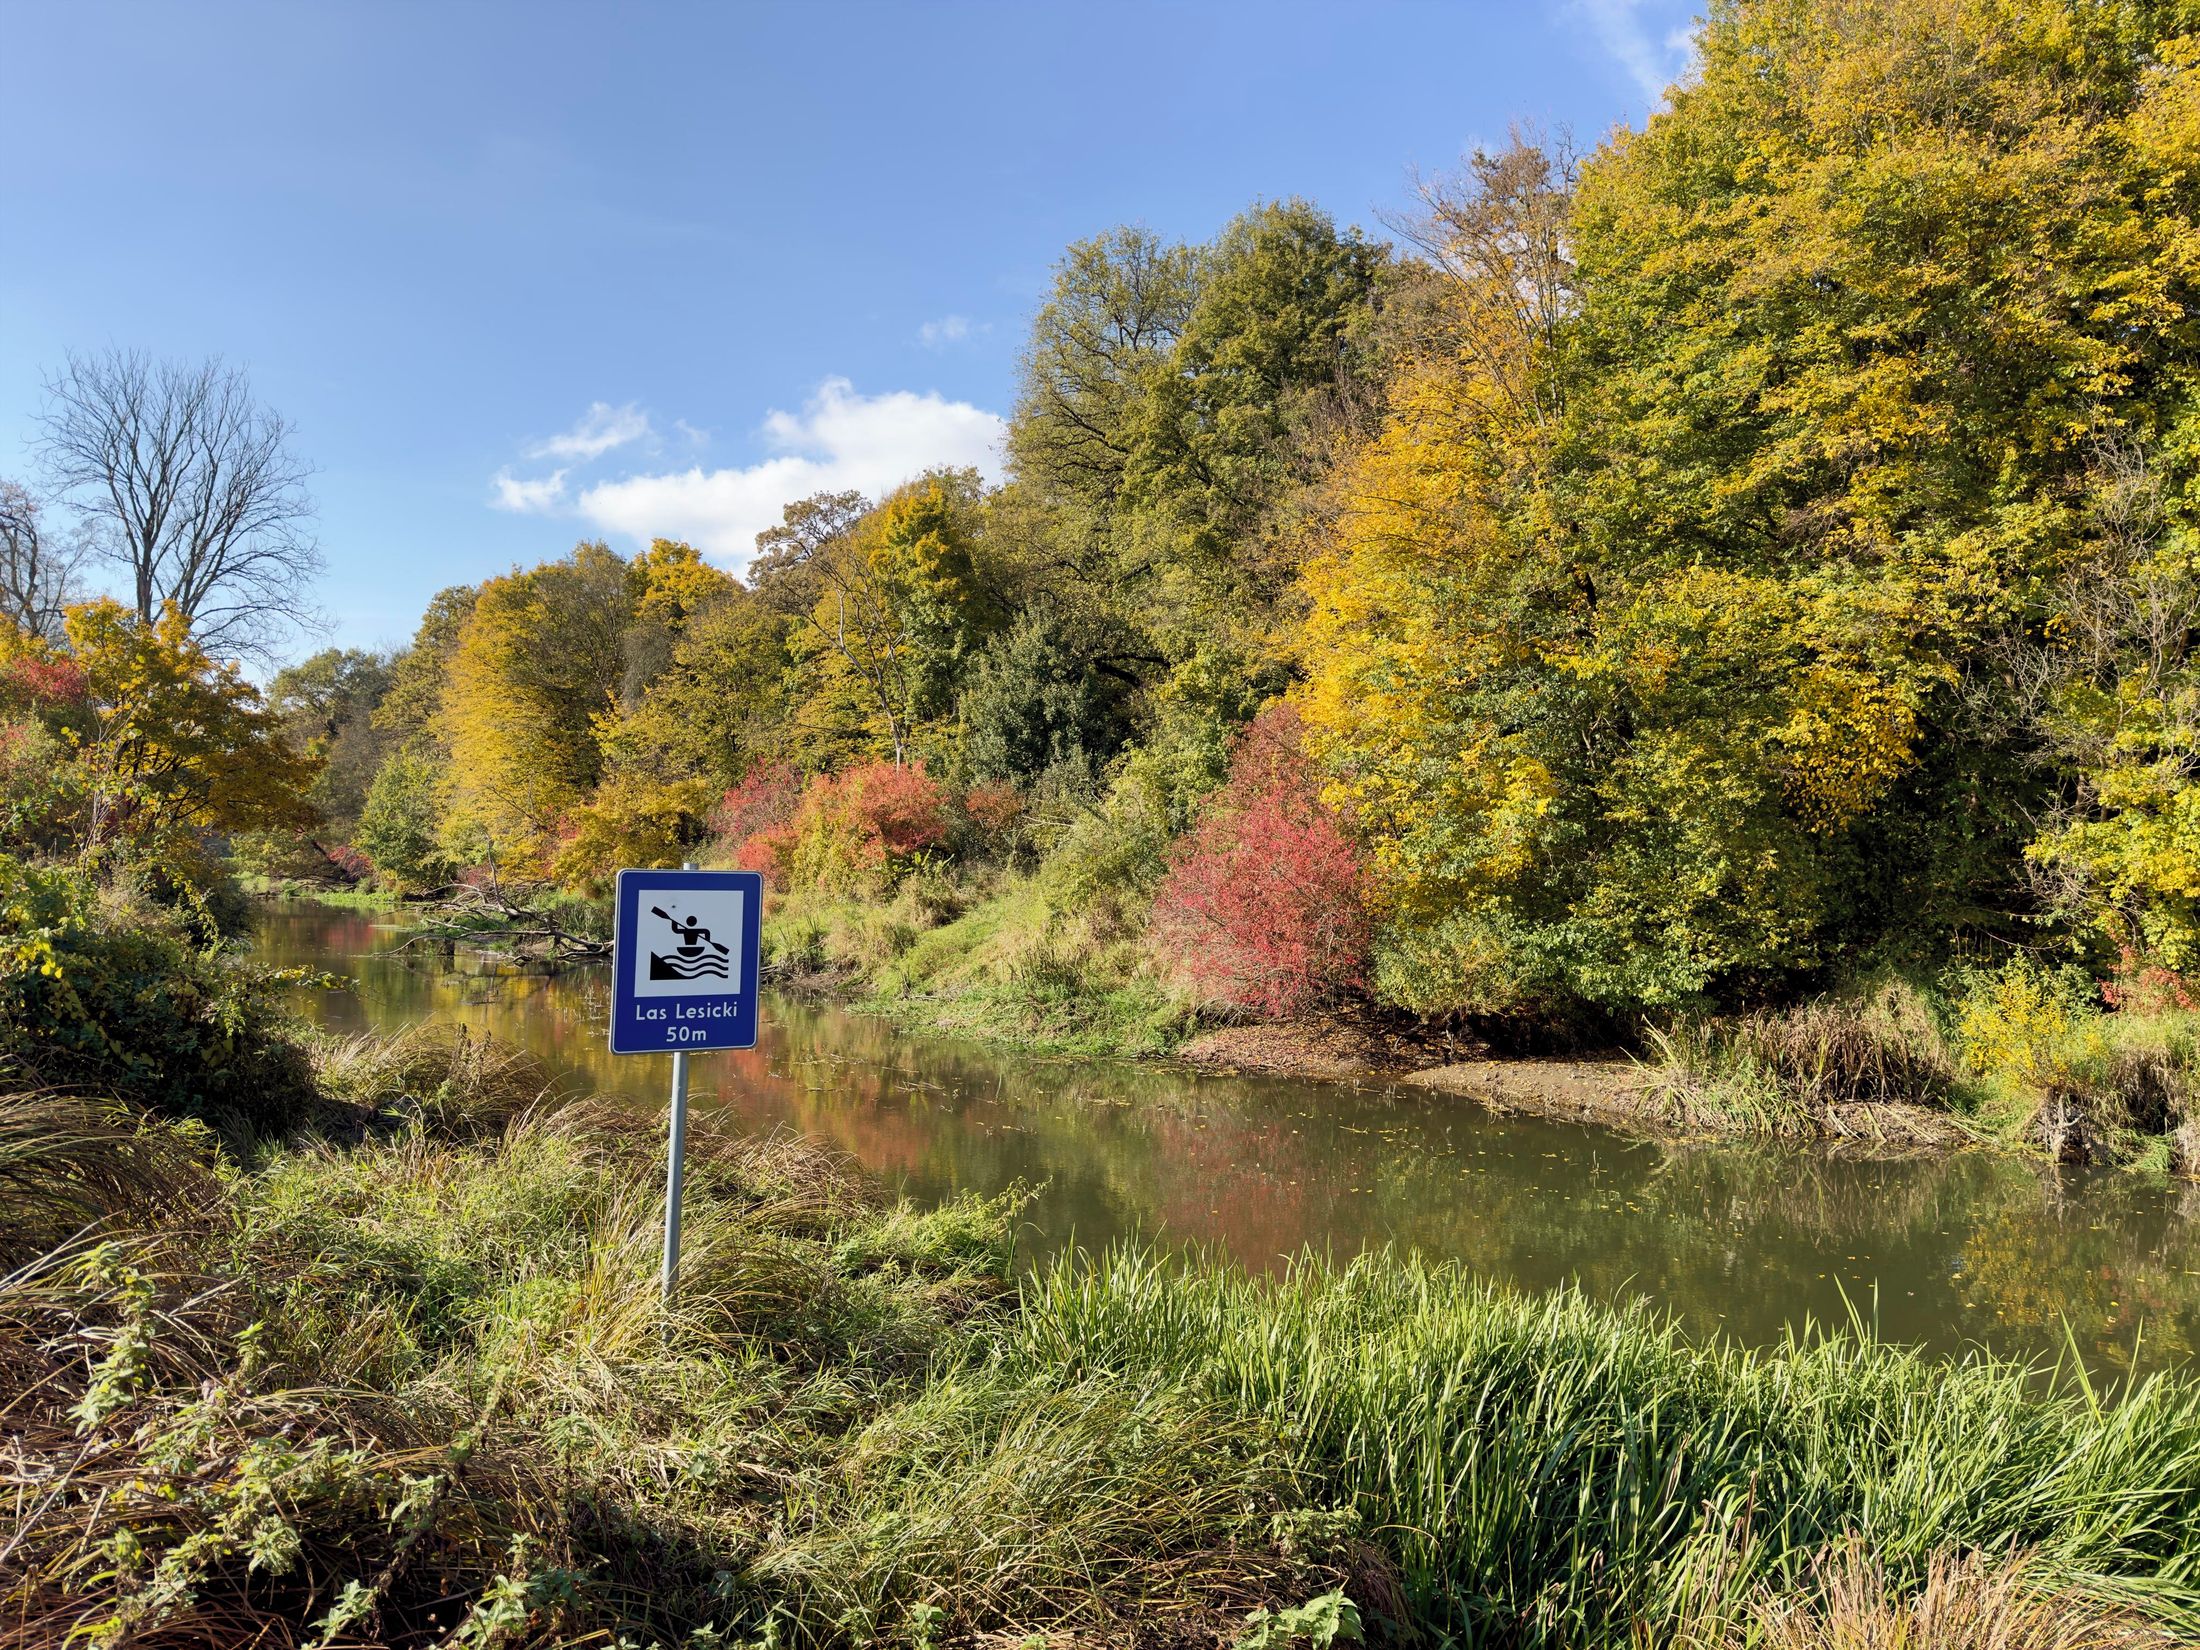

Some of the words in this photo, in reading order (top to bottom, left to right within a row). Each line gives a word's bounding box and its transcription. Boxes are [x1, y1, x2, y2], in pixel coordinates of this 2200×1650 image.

[636, 1005, 667, 1021] Las
[676, 1002, 737, 1019] Lesicki
[666, 1026, 707, 1042] 50m
